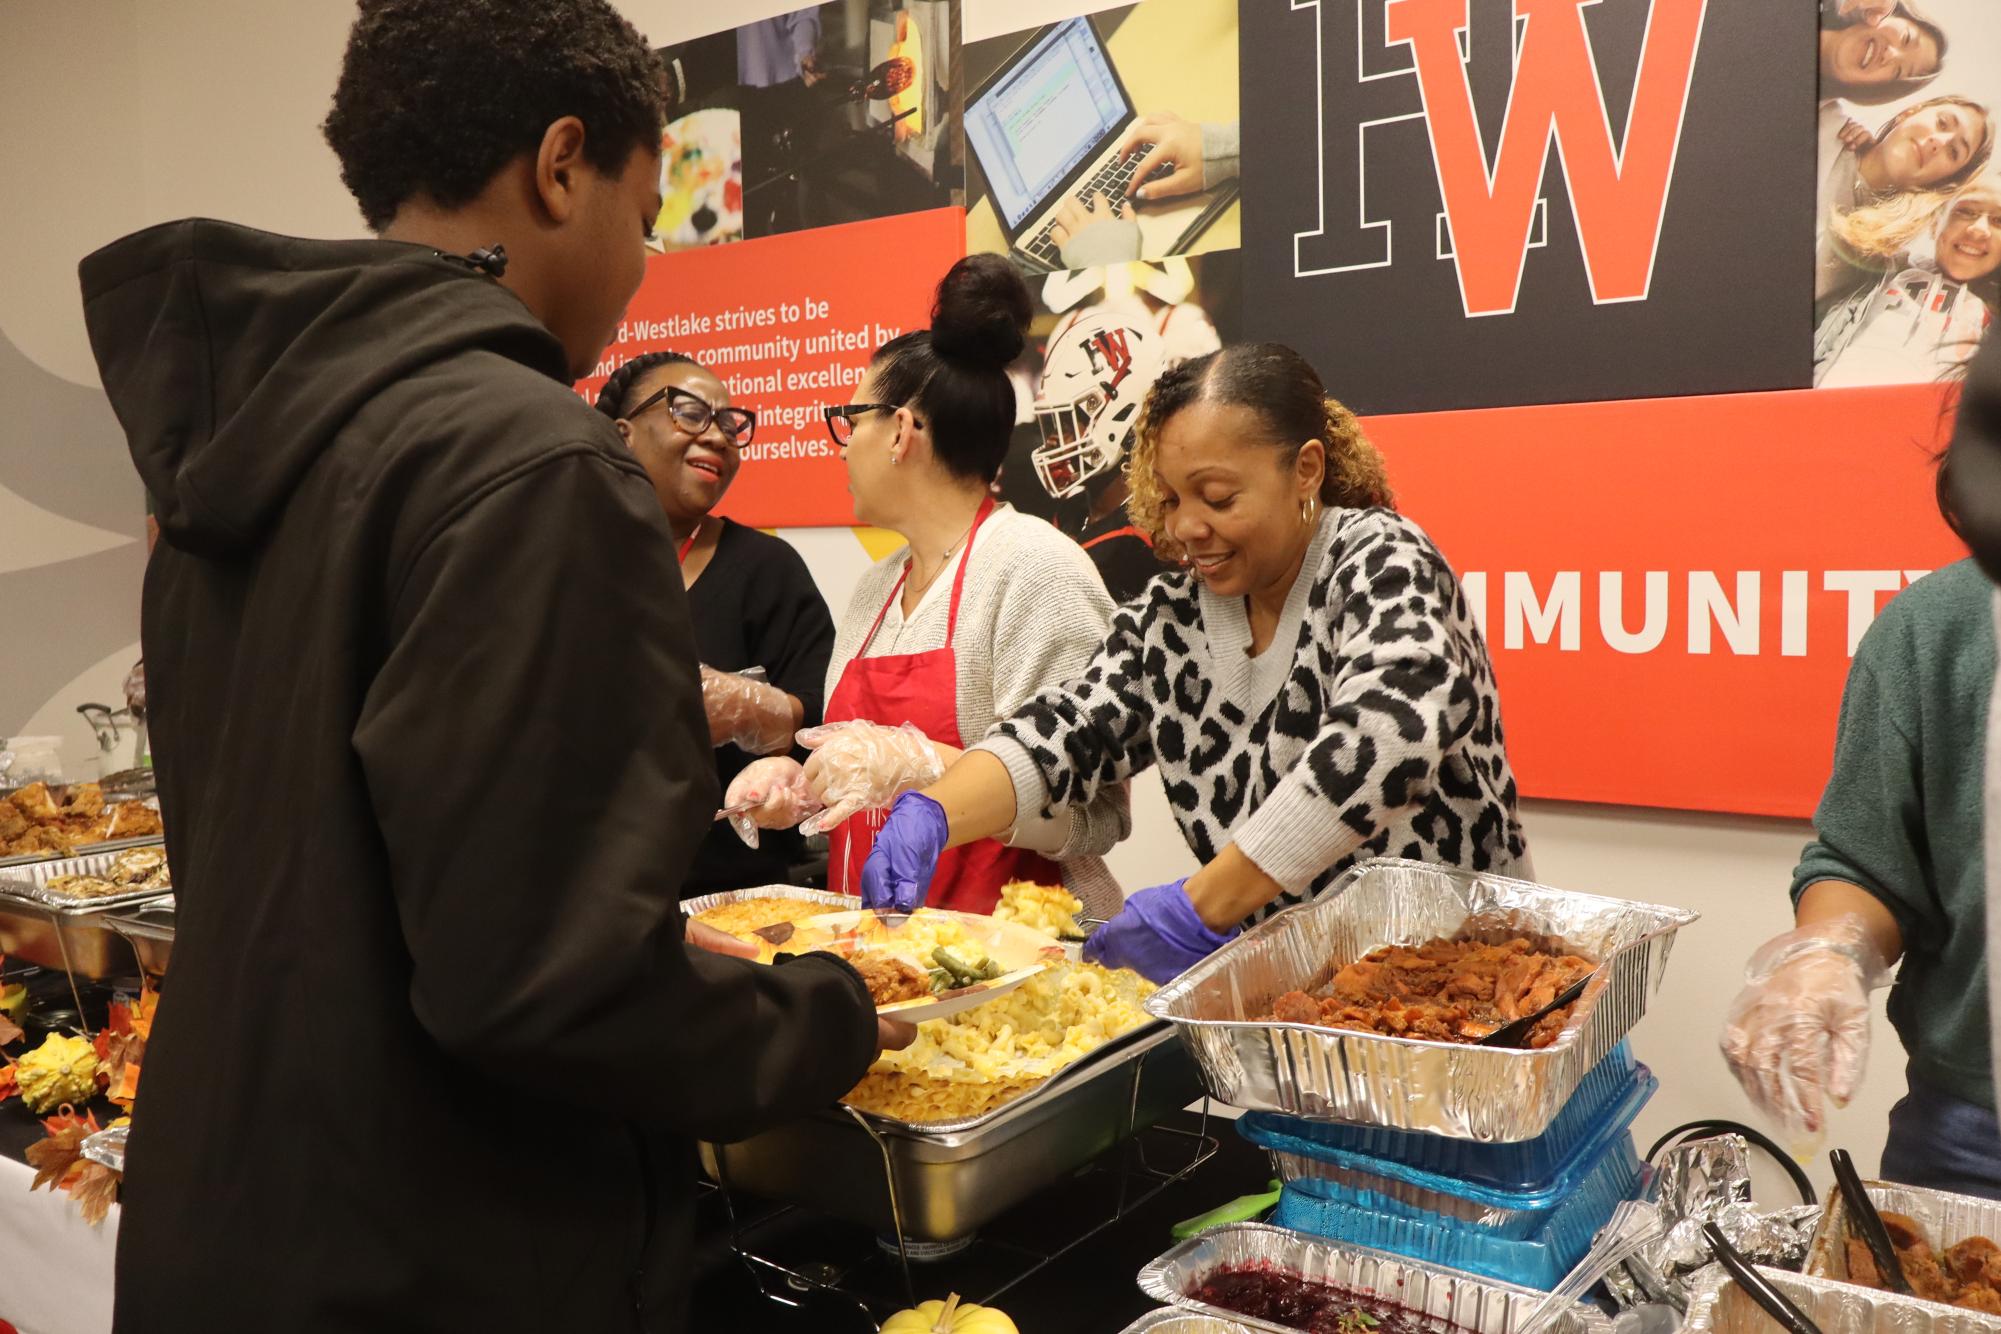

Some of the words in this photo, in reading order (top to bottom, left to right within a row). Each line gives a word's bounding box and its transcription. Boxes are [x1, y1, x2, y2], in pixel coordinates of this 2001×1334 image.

[618, 312, 711, 343] d-Westlake
[715, 306, 776, 331] strives
[780, 302, 800, 323] to
[805, 297, 829, 320] be
[588, 355, 615, 377] nd
[697, 335, 801, 366] community
[806, 325, 869, 354] united
[721, 368, 782, 396] tional
[787, 363, 866, 391] excellen
[757, 399, 837, 431] integrit
[739, 434, 834, 461] ourselves.
[1460, 569, 1933, 658] MUNIT
